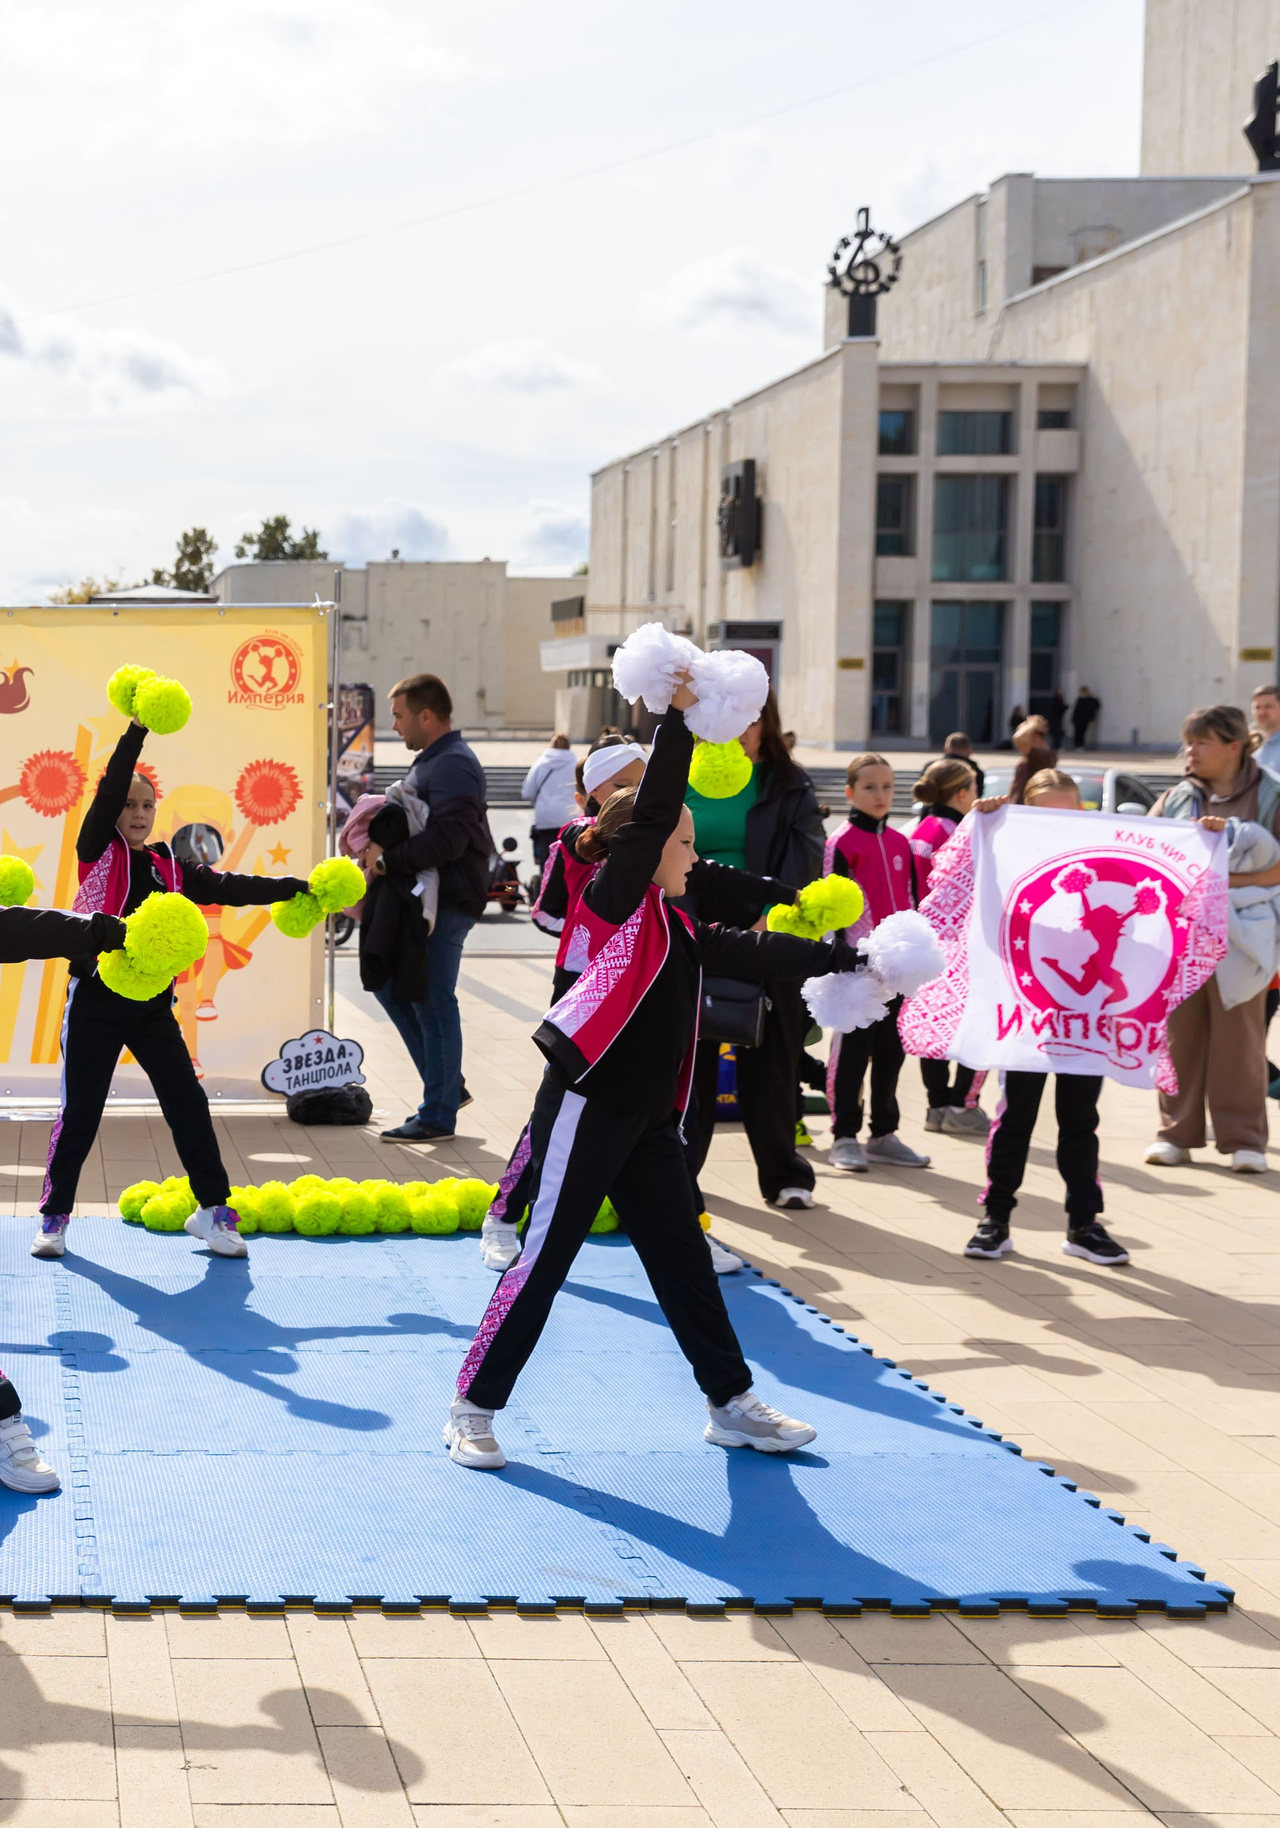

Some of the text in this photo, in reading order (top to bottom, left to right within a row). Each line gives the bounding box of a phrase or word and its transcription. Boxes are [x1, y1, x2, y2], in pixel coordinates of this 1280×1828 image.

[228, 690, 304, 707] Империя
[1115, 830, 1155, 849] КЛУБ
[1160, 843, 1186, 863] ЧИР
[282, 1044, 352, 1090] ЗВЕЗДА ТАНЦПОЛА
